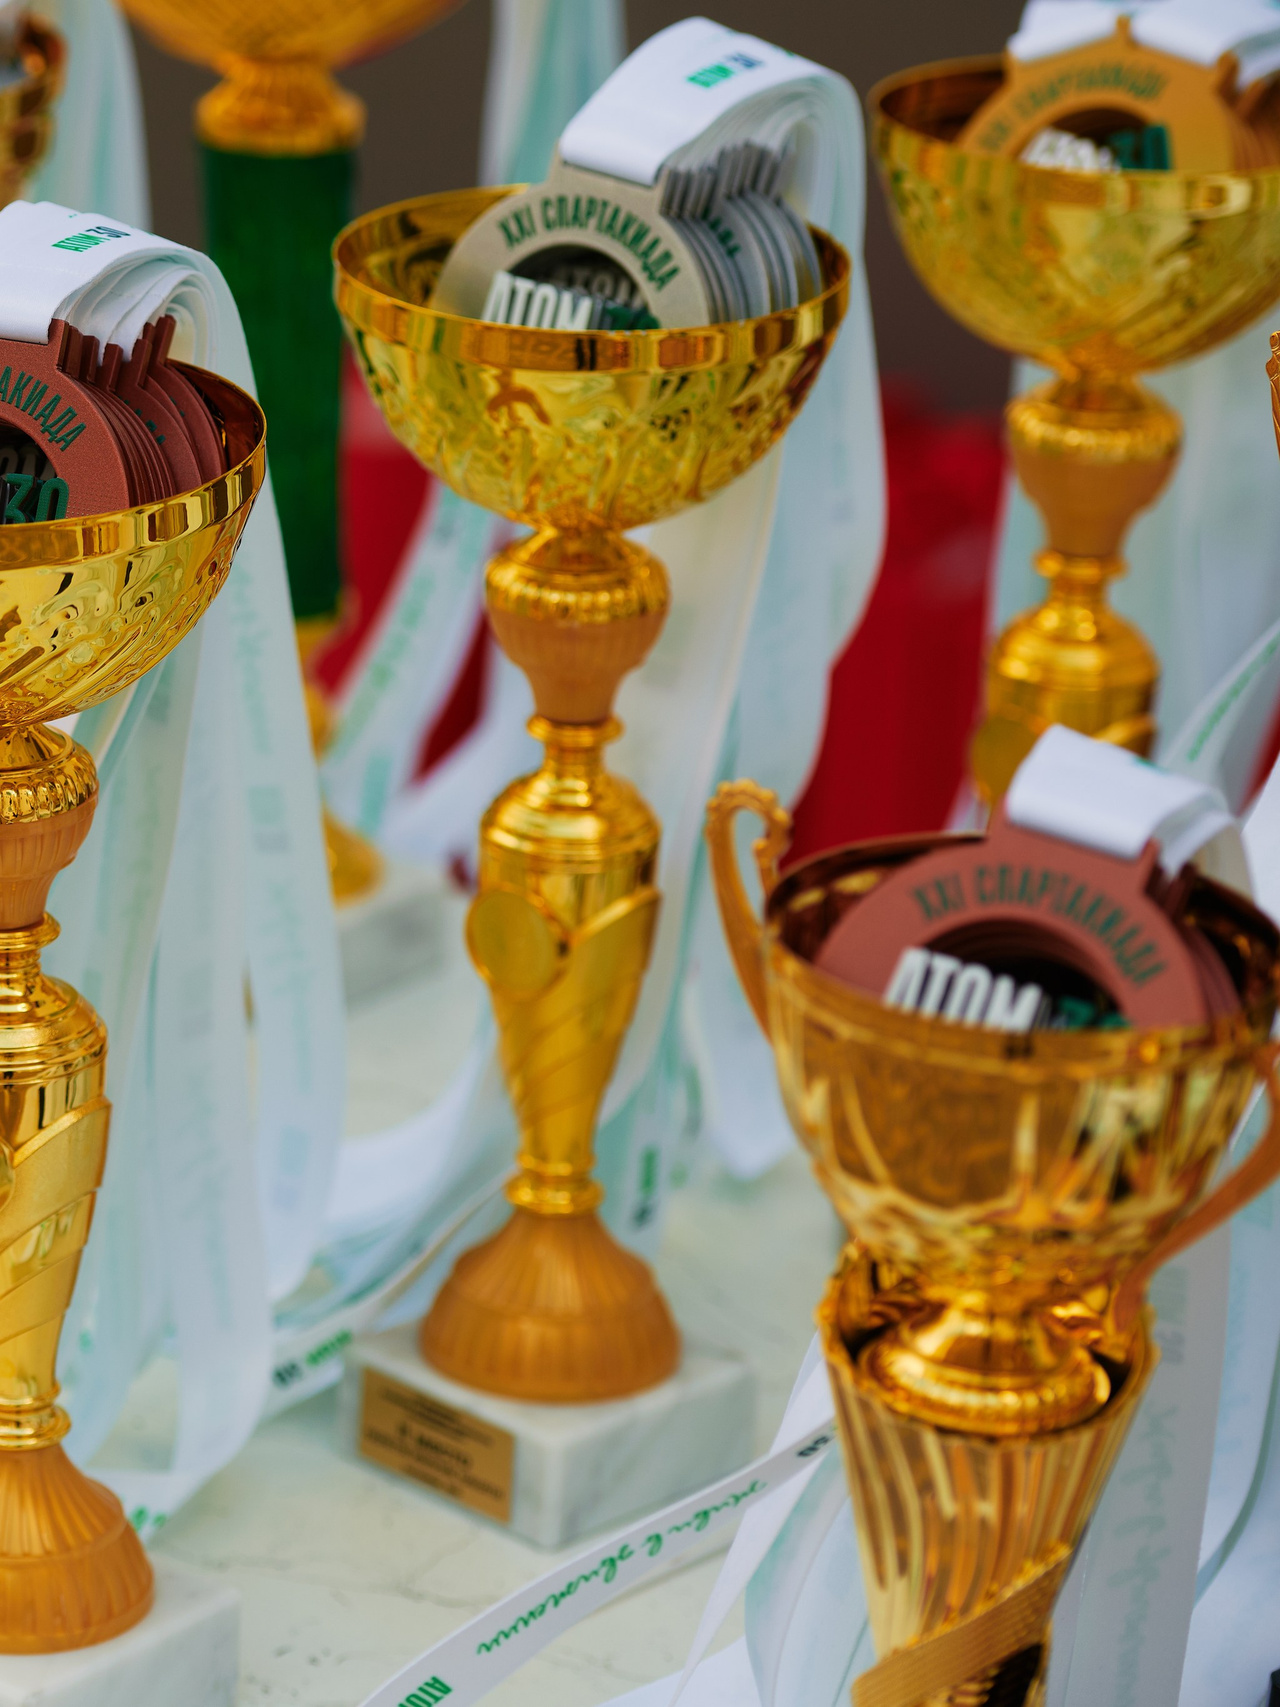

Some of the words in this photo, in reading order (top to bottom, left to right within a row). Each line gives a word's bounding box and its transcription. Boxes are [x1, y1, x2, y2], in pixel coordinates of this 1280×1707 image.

[51, 233, 110, 252] АТОМ
[85, 226, 131, 238] 30
[541, 195, 680, 291] СПАРТАКИАДА
[4, 474, 70, 524] 30
[397, 1676, 453, 1707] АТО
